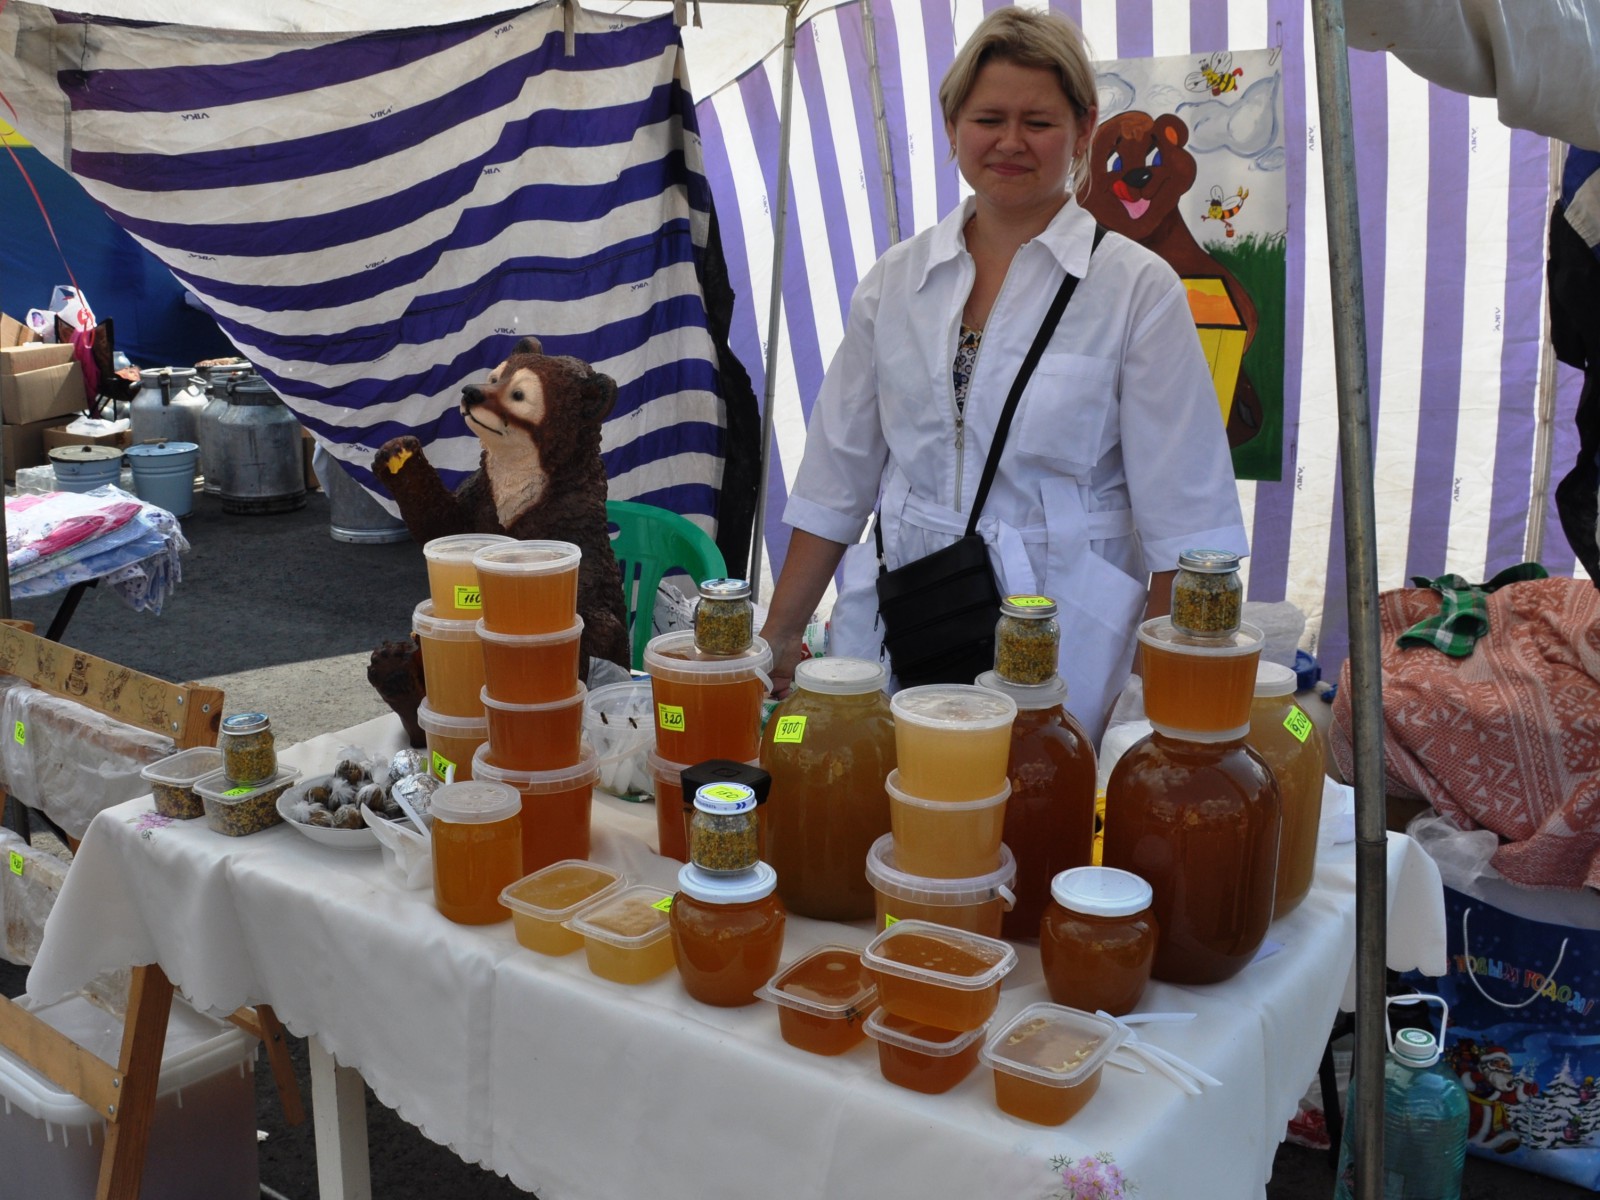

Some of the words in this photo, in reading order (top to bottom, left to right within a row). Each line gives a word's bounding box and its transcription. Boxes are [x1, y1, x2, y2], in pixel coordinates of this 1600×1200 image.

[484, 167, 501, 176] VIK
[664, 712, 682, 725] 320
[1291, 712, 1307, 735] 900
[782, 721, 799, 735] 900
